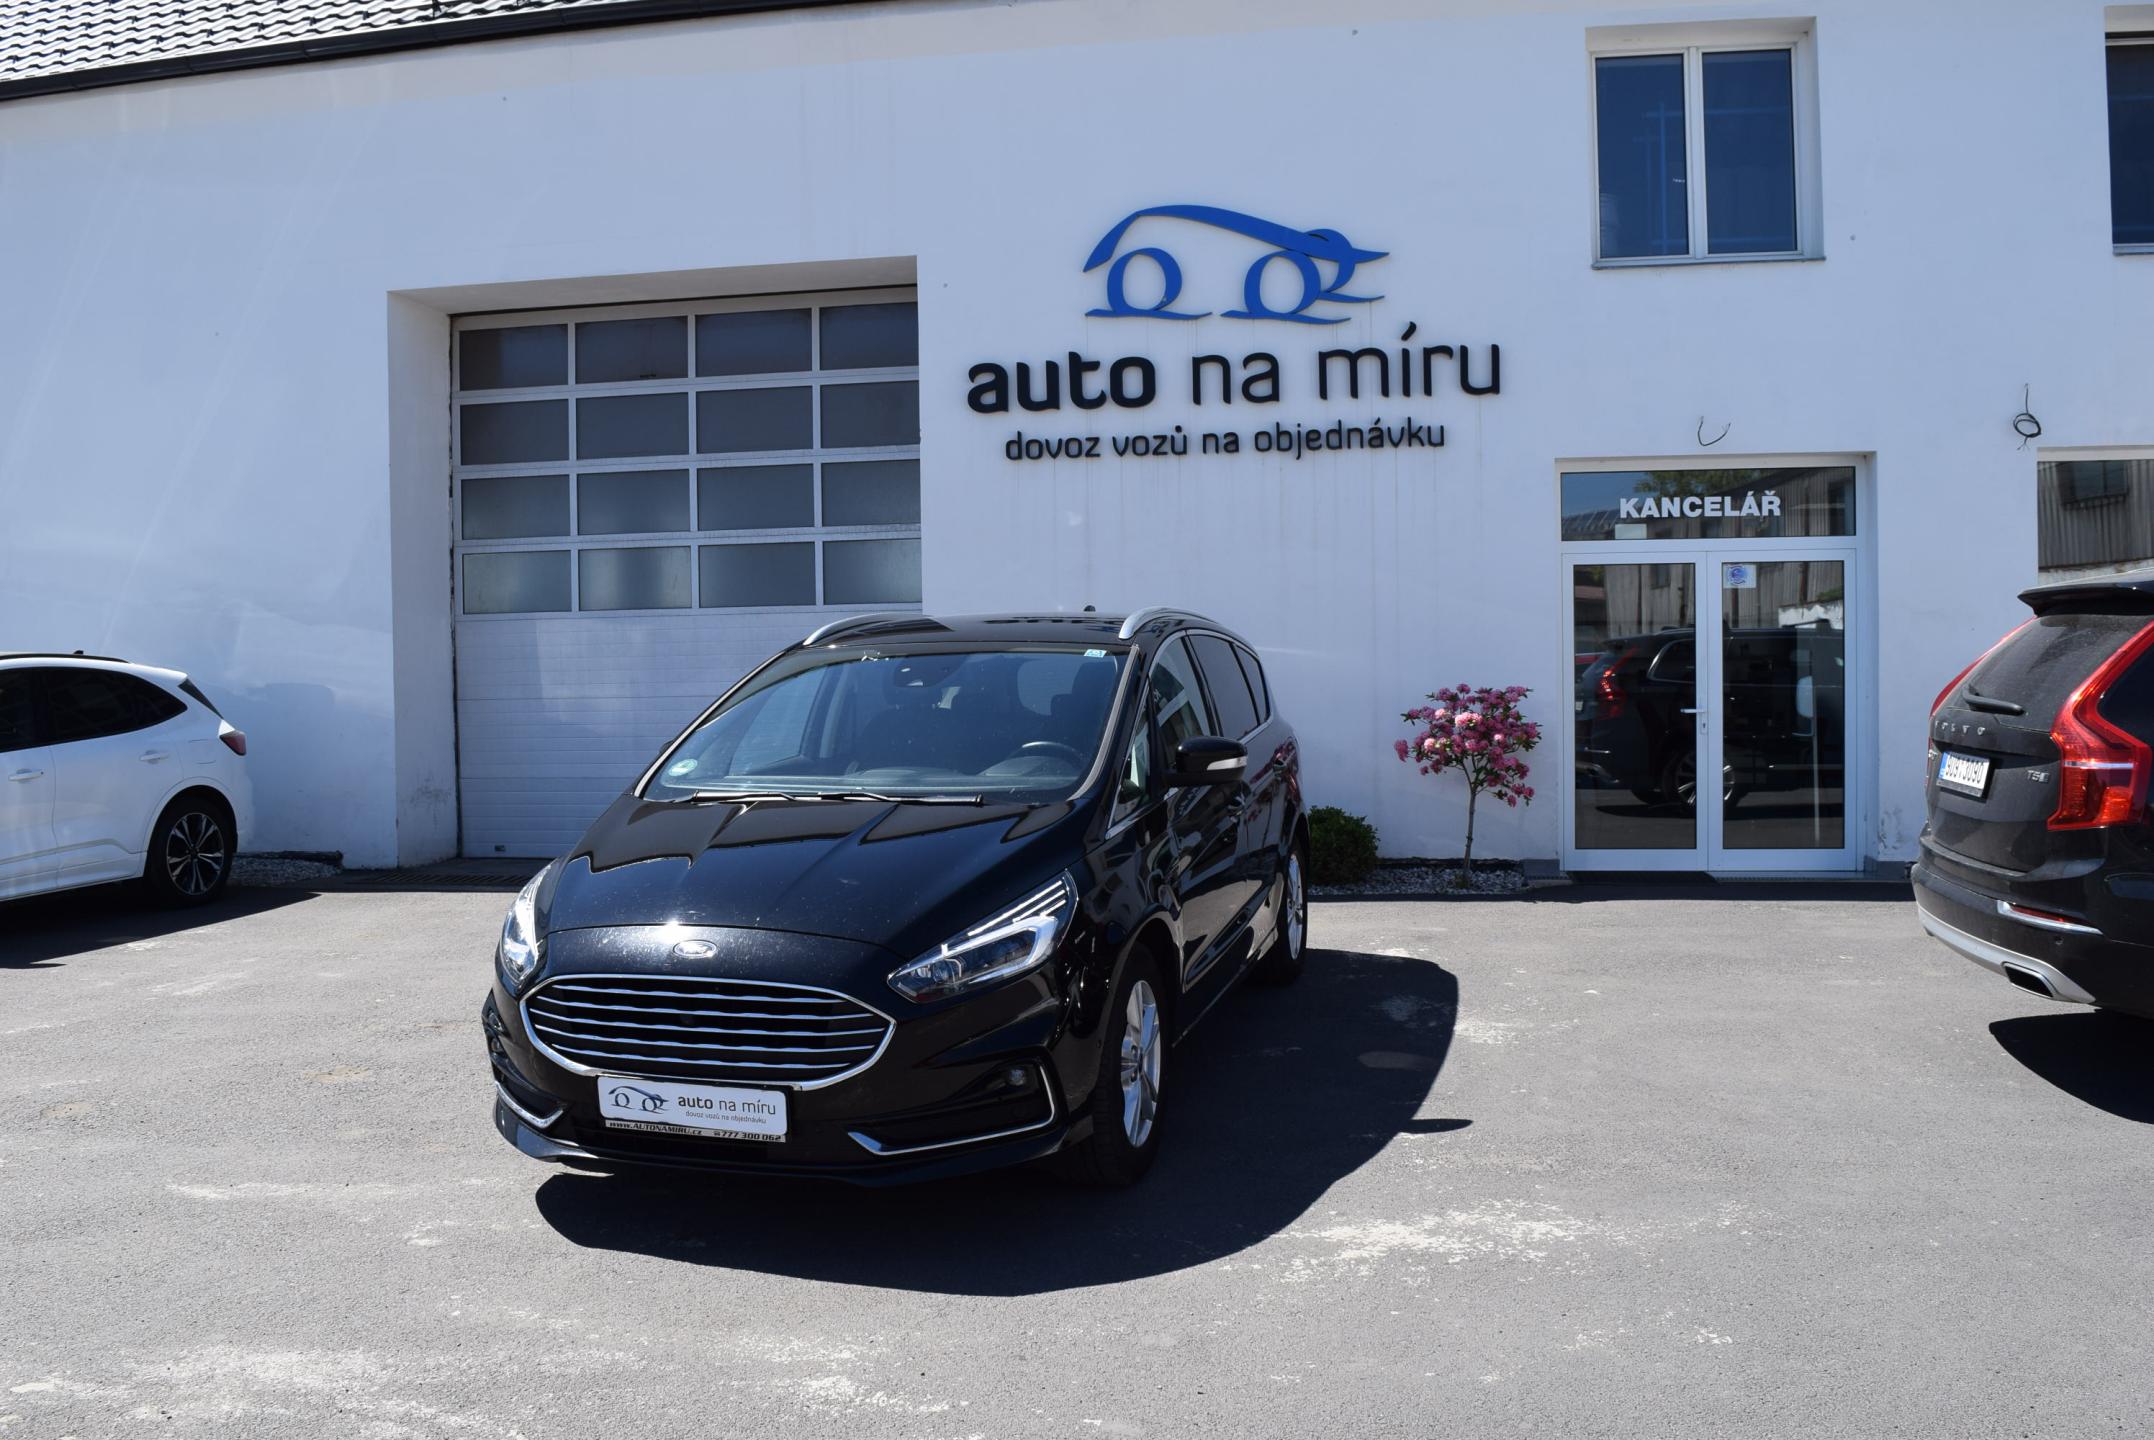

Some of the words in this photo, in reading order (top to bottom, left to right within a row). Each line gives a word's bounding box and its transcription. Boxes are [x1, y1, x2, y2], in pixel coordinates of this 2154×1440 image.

[967, 352, 1156, 413] auto
[1193, 352, 1279, 405] na
[1319, 322, 1500, 399] míru
[1006, 431, 1100, 460] dovoz
[1112, 426, 1187, 457] vozů
[1203, 432, 1239, 454] na
[1255, 417, 1444, 460] objednávku
[1620, 490, 1781, 518] KANCELÁŘ
[678, 1096, 713, 1109] auto
[719, 1100, 736, 1112] na
[742, 1099, 776, 1115] míru
